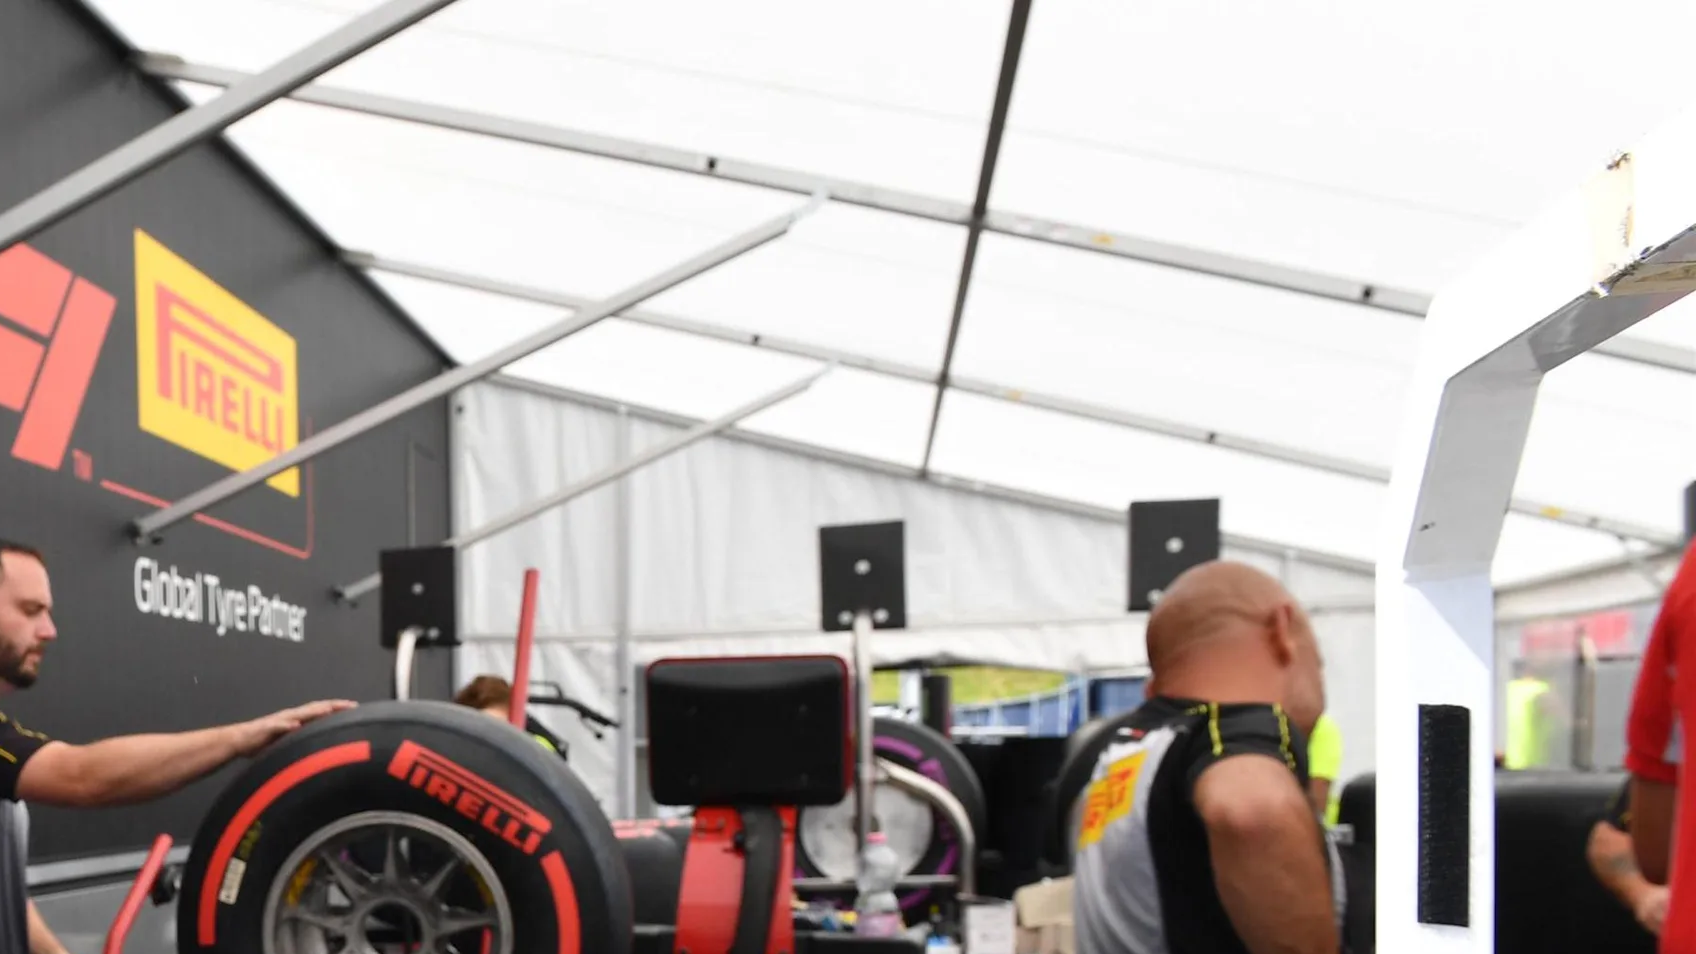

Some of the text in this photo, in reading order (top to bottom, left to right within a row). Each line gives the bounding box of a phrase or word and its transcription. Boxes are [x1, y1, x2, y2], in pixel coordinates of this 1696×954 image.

[155, 282, 284, 455] PIRELLI
[133, 556, 307, 642] Global Tyre Partner
[387, 740, 552, 853] PIRELLI
